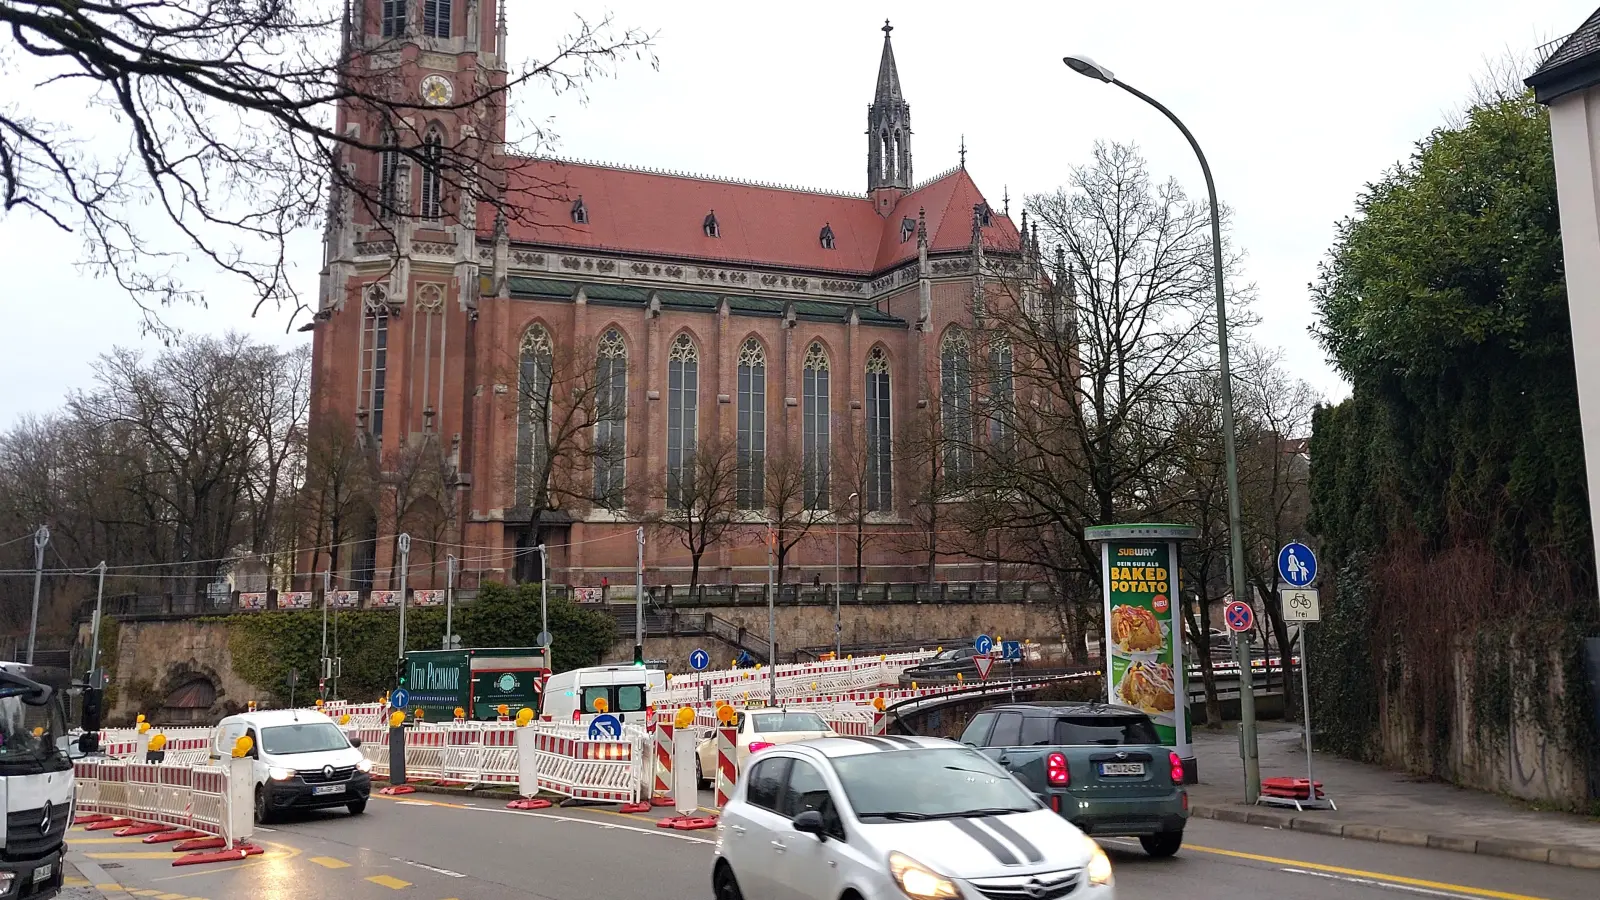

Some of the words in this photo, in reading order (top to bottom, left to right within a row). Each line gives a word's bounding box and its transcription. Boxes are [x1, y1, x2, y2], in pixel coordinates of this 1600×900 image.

[1117, 547, 1157, 557] SUBWAY
[1110, 567, 1168, 581] BAKED
[1111, 580, 1168, 593] POTATO
[1153, 600, 1168, 608] NEU
[1295, 610, 1308, 618] frei
